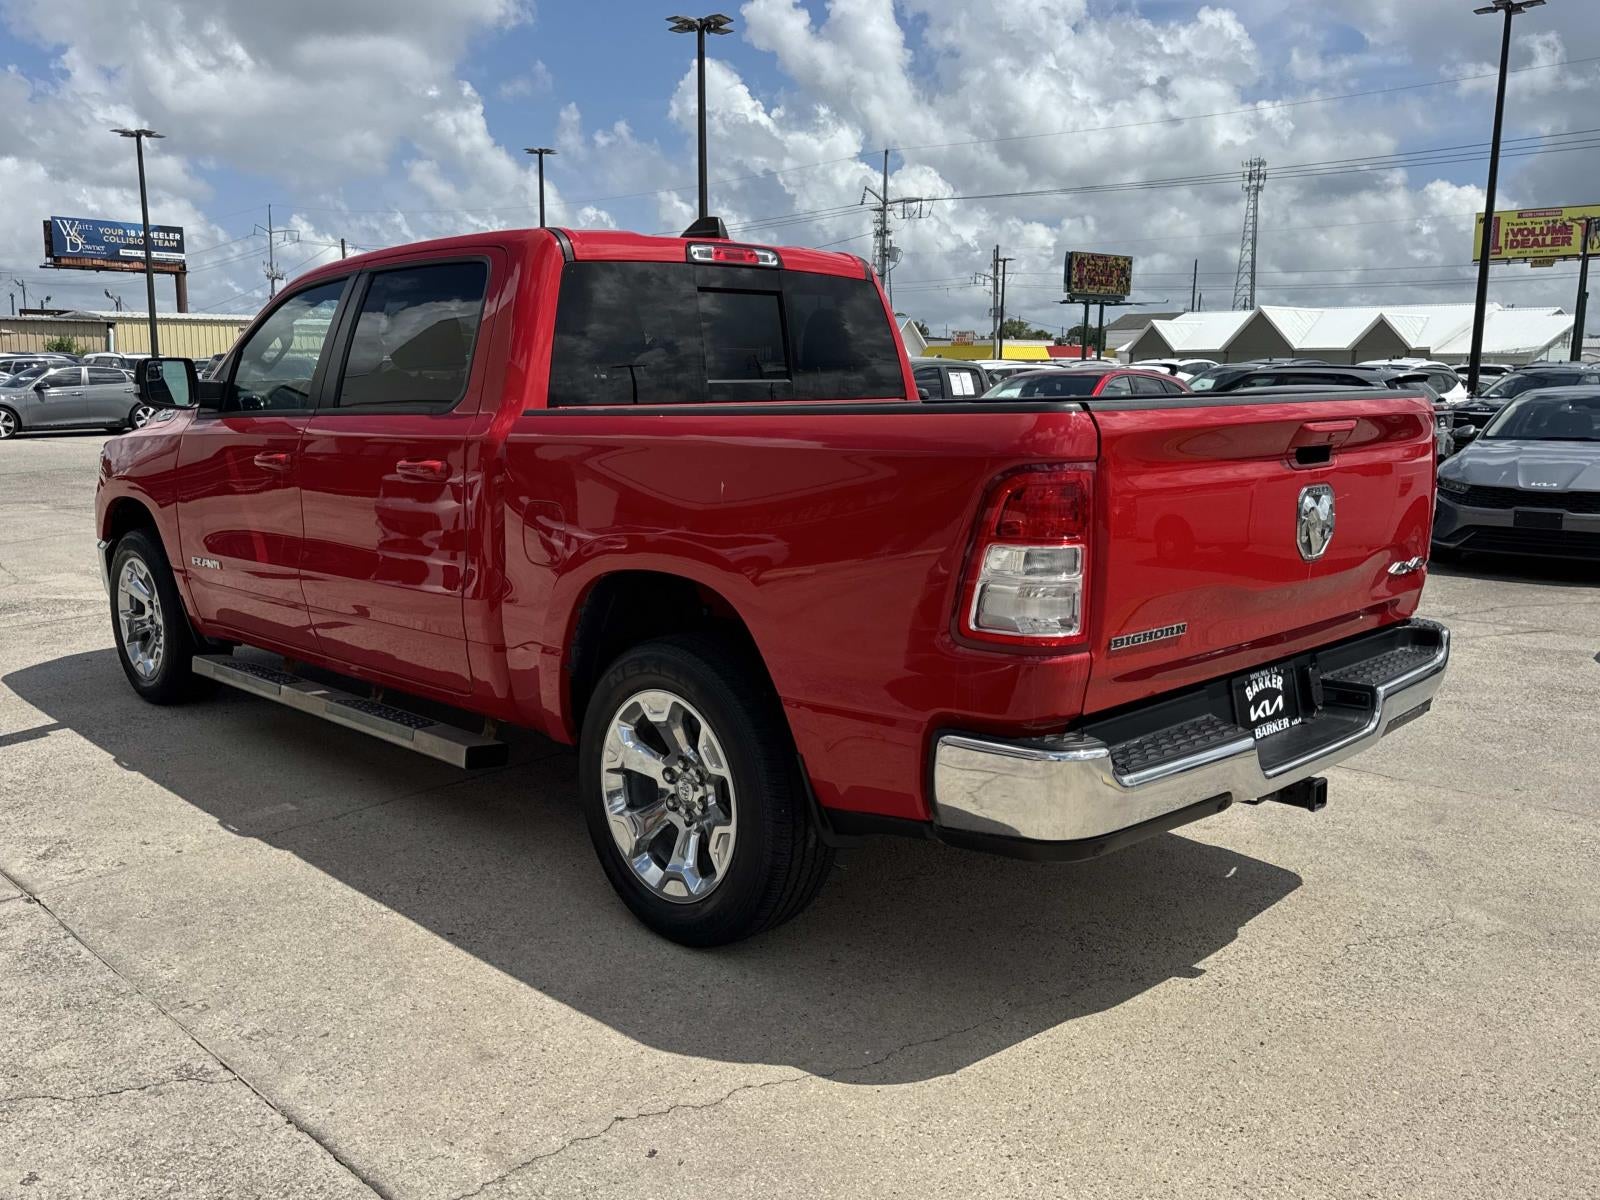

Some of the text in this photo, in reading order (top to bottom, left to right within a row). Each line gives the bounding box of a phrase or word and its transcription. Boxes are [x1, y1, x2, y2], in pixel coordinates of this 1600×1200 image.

[99, 227, 124, 236] YOUR
[126, 229, 136, 237] 18
[1509, 224, 1573, 238] VOLUME
[103, 235, 145, 245] COLLISIO
[1509, 236, 1572, 249] DEALER
[191, 556, 221, 570] RAM
[1110, 622, 1187, 651] BIGHORN
[1245, 674, 1284, 702] BARKER
[1250, 694, 1284, 722] KIA
[1254, 717, 1290, 740] BARKER
